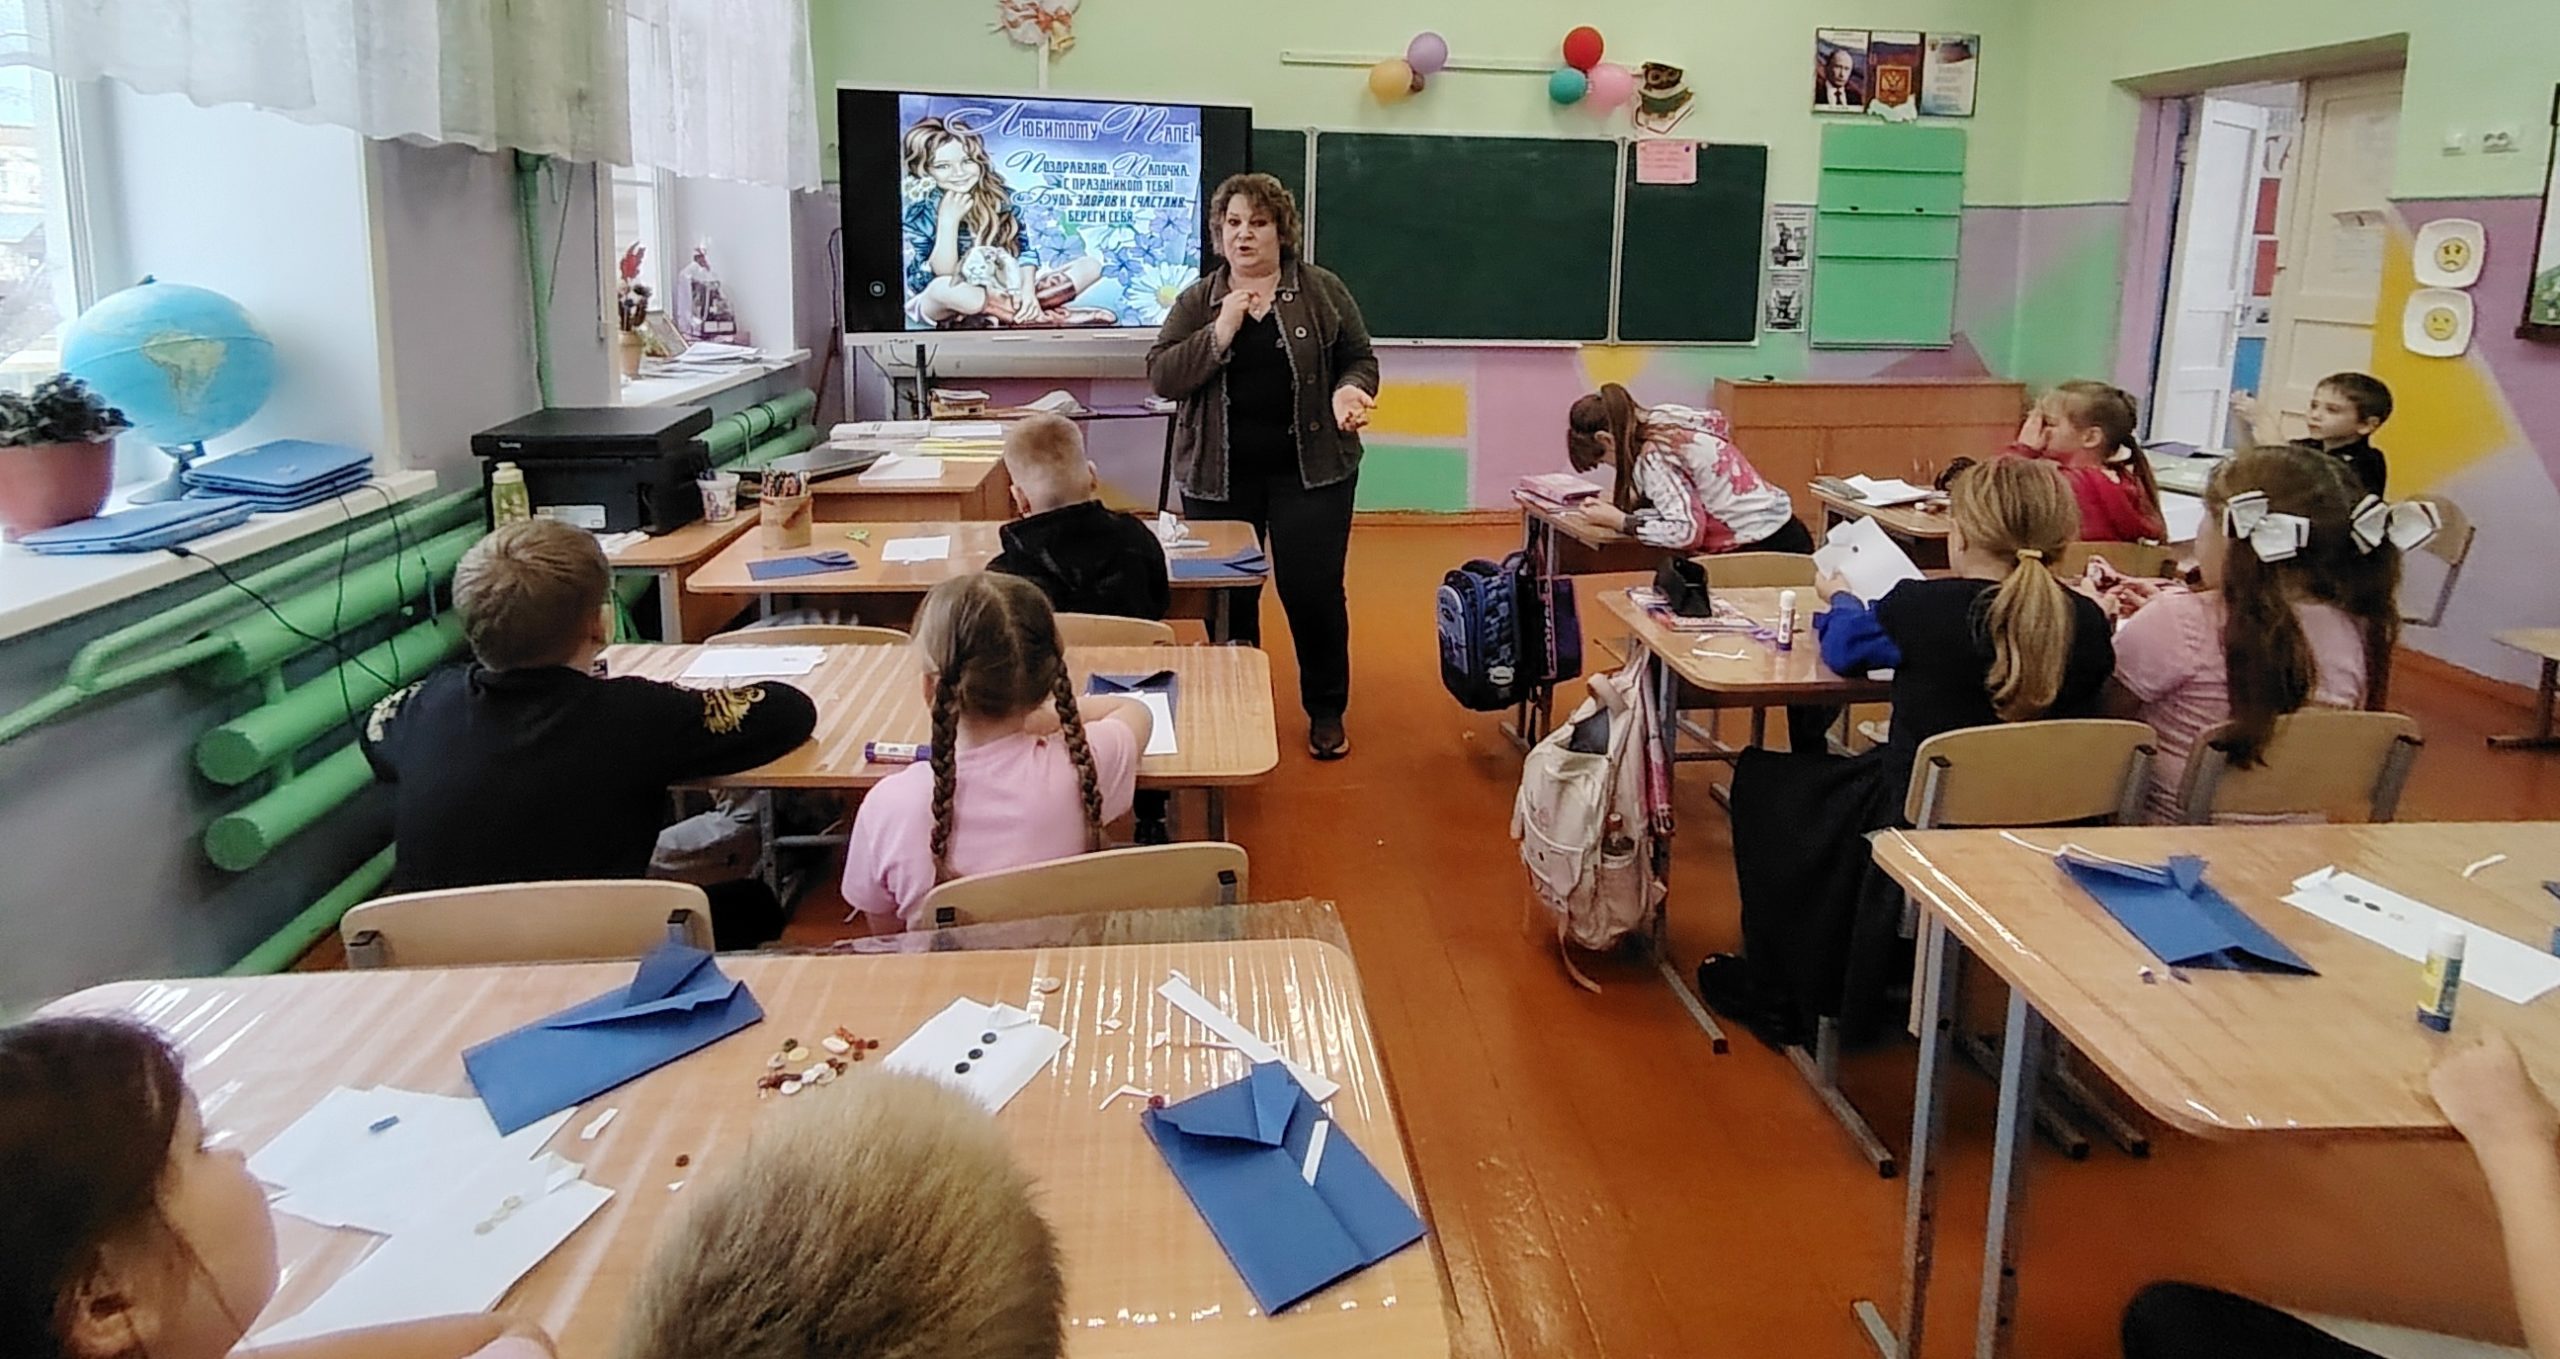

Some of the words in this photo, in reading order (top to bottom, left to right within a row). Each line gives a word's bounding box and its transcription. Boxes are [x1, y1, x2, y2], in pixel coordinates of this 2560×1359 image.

[1075, 194, 1118, 207] ЗДОРОВ
[1119, 195, 1127, 207] И
[1068, 210, 1106, 223] БЕРЕГИ
